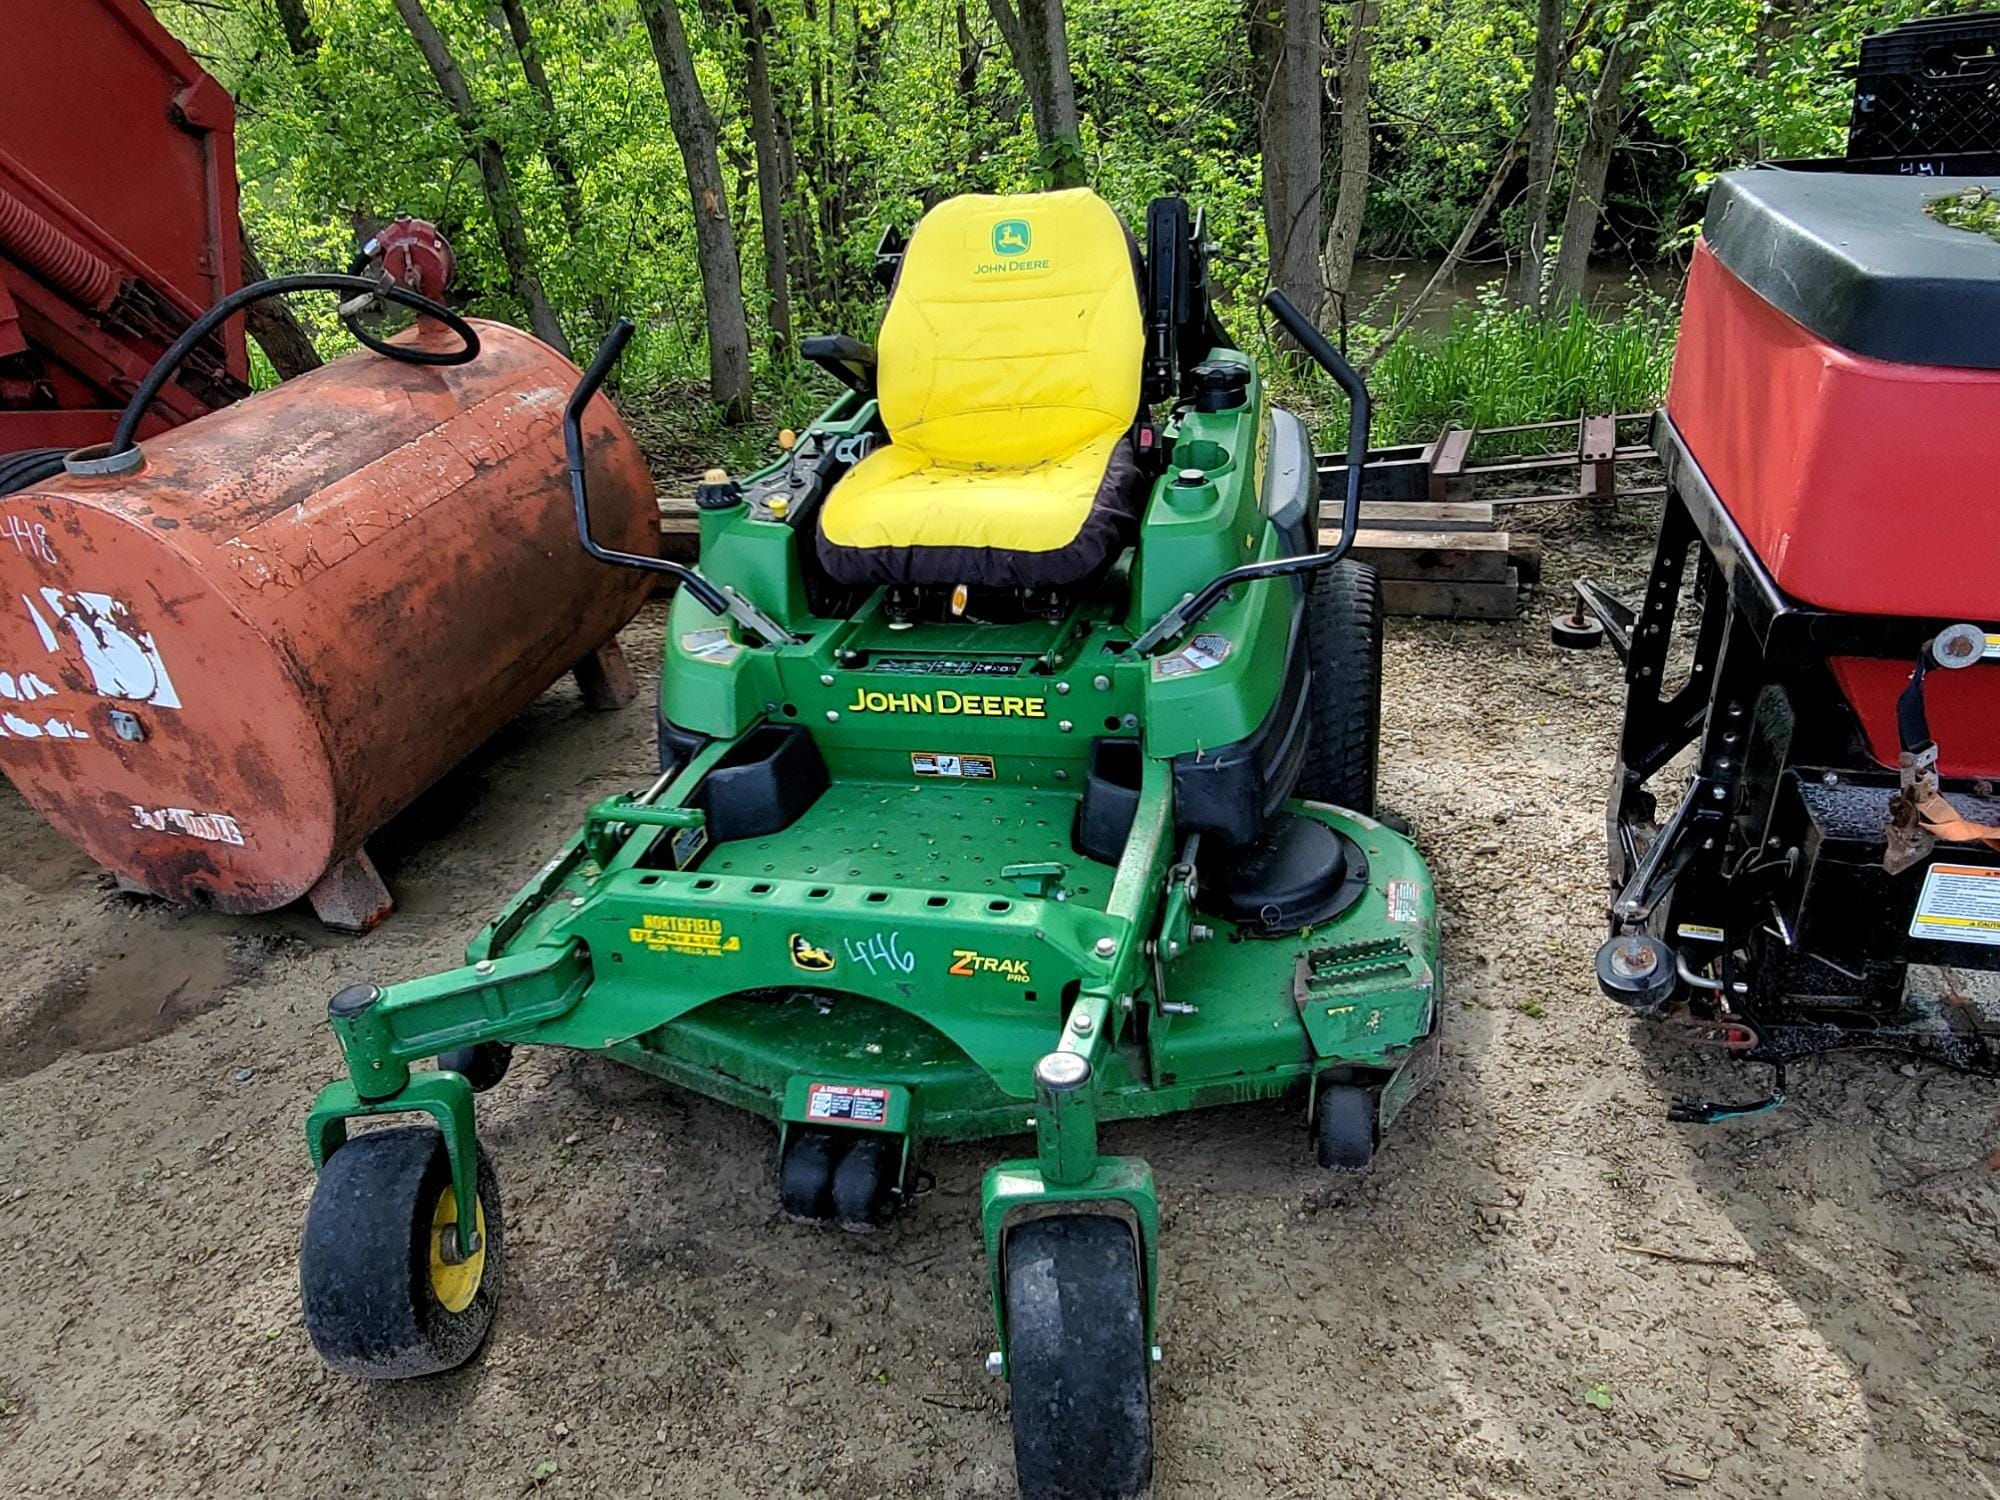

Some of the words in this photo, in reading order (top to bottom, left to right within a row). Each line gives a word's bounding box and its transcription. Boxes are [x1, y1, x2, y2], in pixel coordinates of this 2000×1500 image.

[1900, 161, 1944, 176] 441
[973, 263, 1007, 275] JOHN
[1009, 259, 1050, 272] DEERE
[0, 515, 57, 564] 448
[848, 688, 933, 714] JOHN
[936, 690, 1046, 718] DEERE
[844, 931, 915, 976] 446
[1007, 973, 1031, 984] PRO
